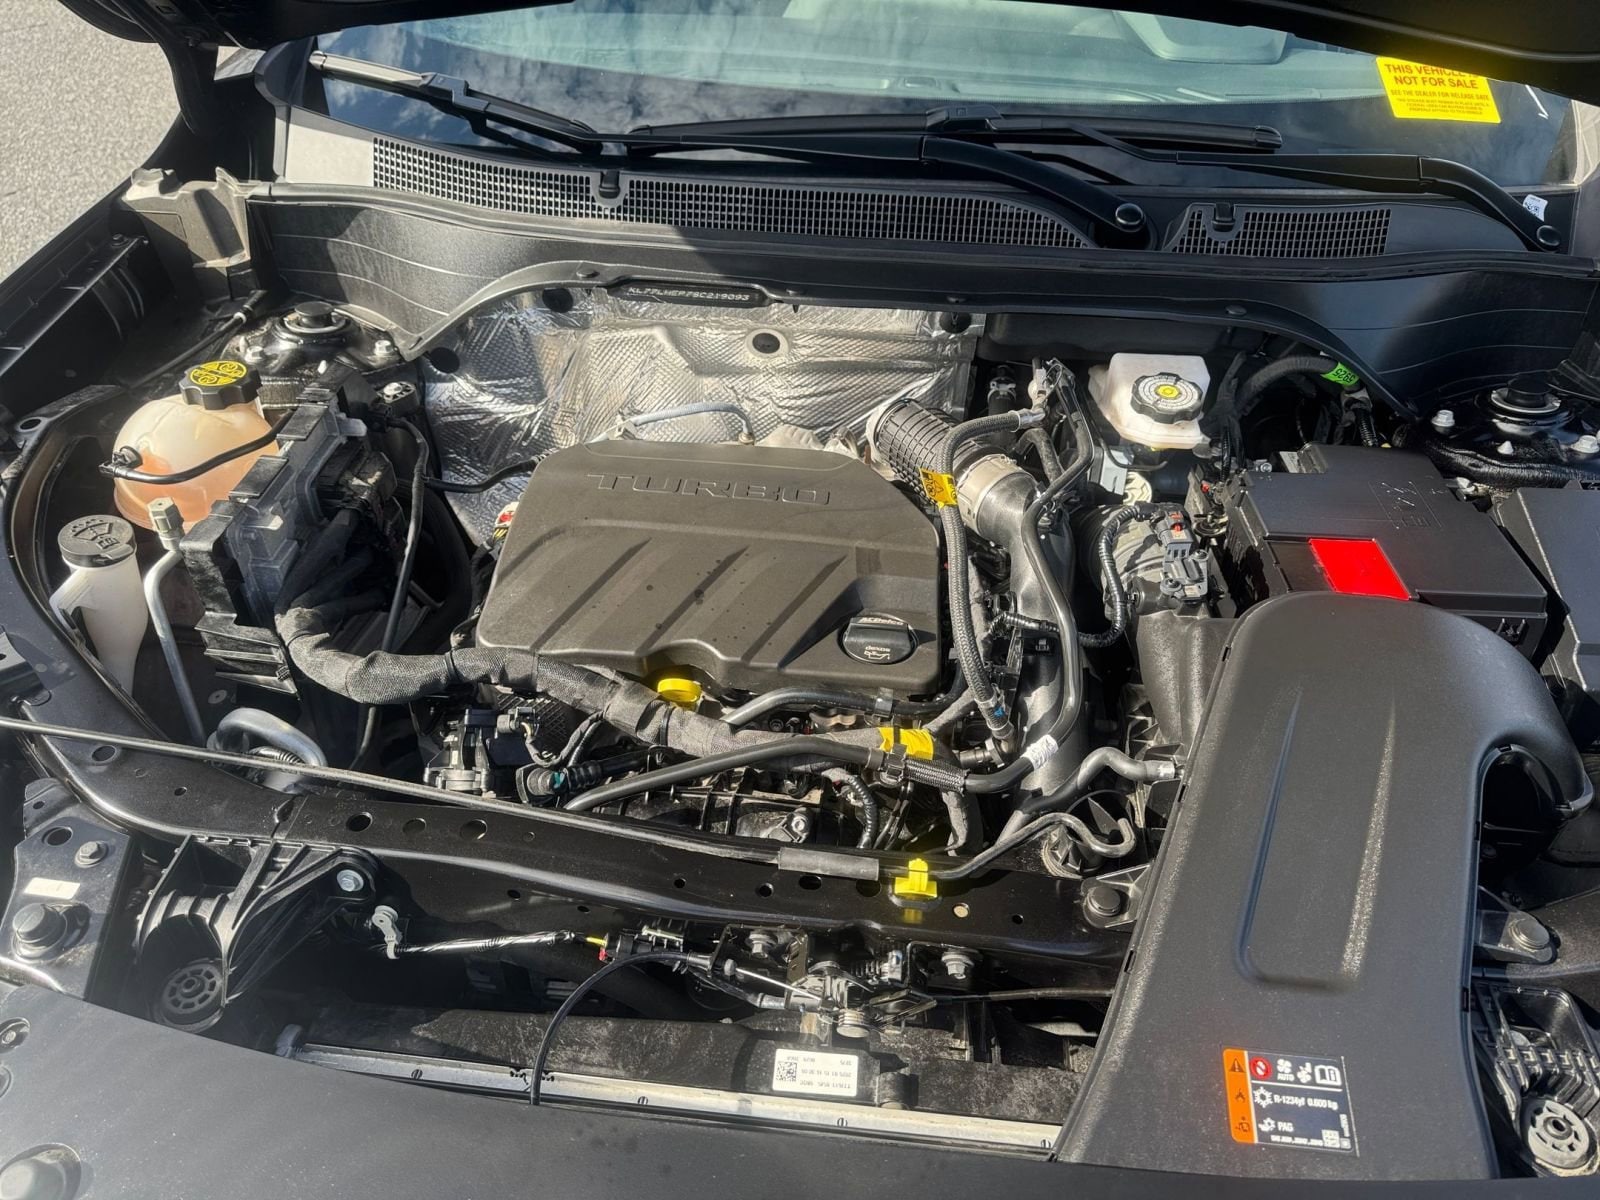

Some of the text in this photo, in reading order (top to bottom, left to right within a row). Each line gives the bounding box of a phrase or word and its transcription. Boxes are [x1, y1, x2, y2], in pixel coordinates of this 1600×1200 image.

[1385, 64, 1413, 74] THIS
[1394, 76, 1479, 89] NOT FOR SALE
[586, 472, 831, 505] TURBO
[857, 616, 905, 626] ACDelco
[865, 645, 891, 653] dexos
[1277, 1073, 1295, 1081] AUTO
[1328, 1100, 1339, 1111] kg
[1277, 1121, 1294, 1132] PAG
